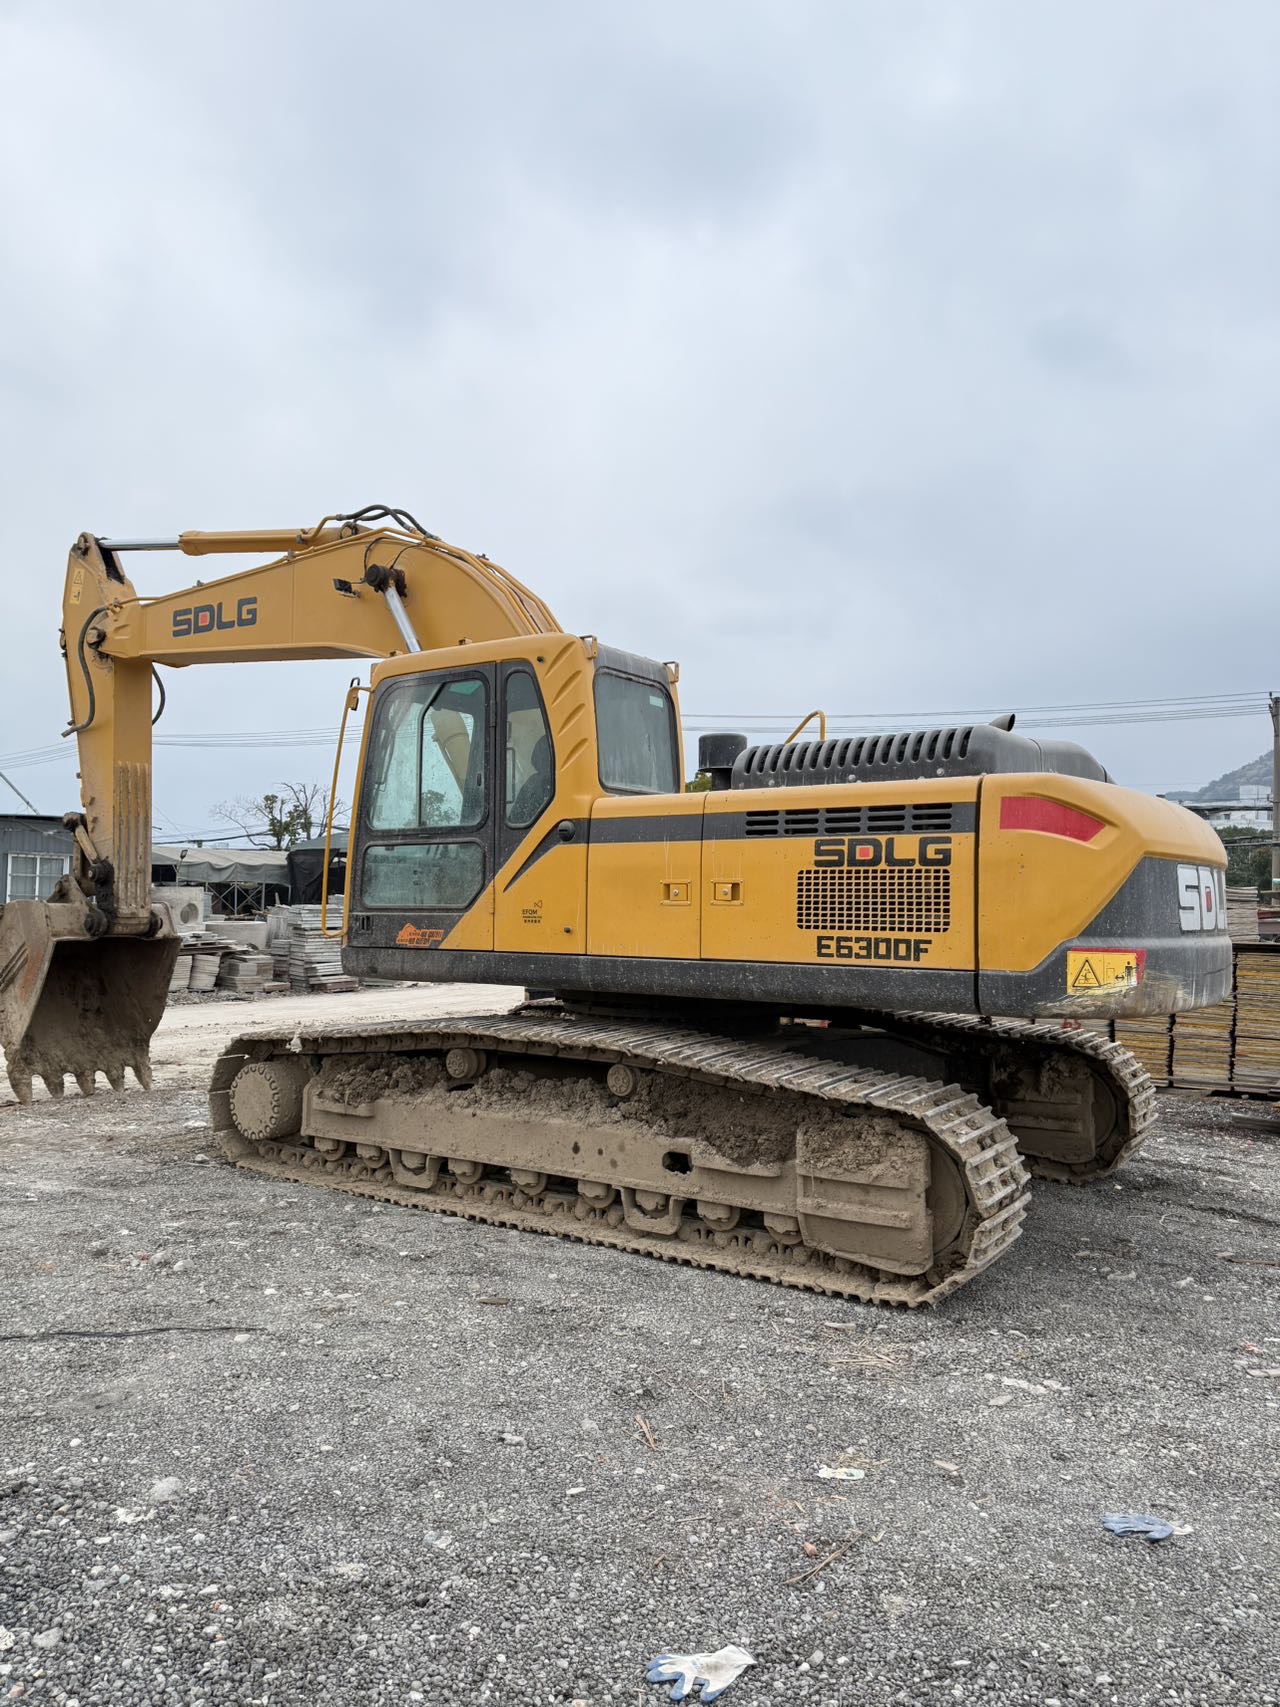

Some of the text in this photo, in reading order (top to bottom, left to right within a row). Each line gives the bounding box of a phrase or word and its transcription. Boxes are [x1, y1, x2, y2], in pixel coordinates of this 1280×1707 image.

[172, 596, 257, 637] SDLG
[814, 836, 952, 867] SDLG
[1177, 864, 1227, 930] SDL
[816, 935, 932, 961] E6300F
